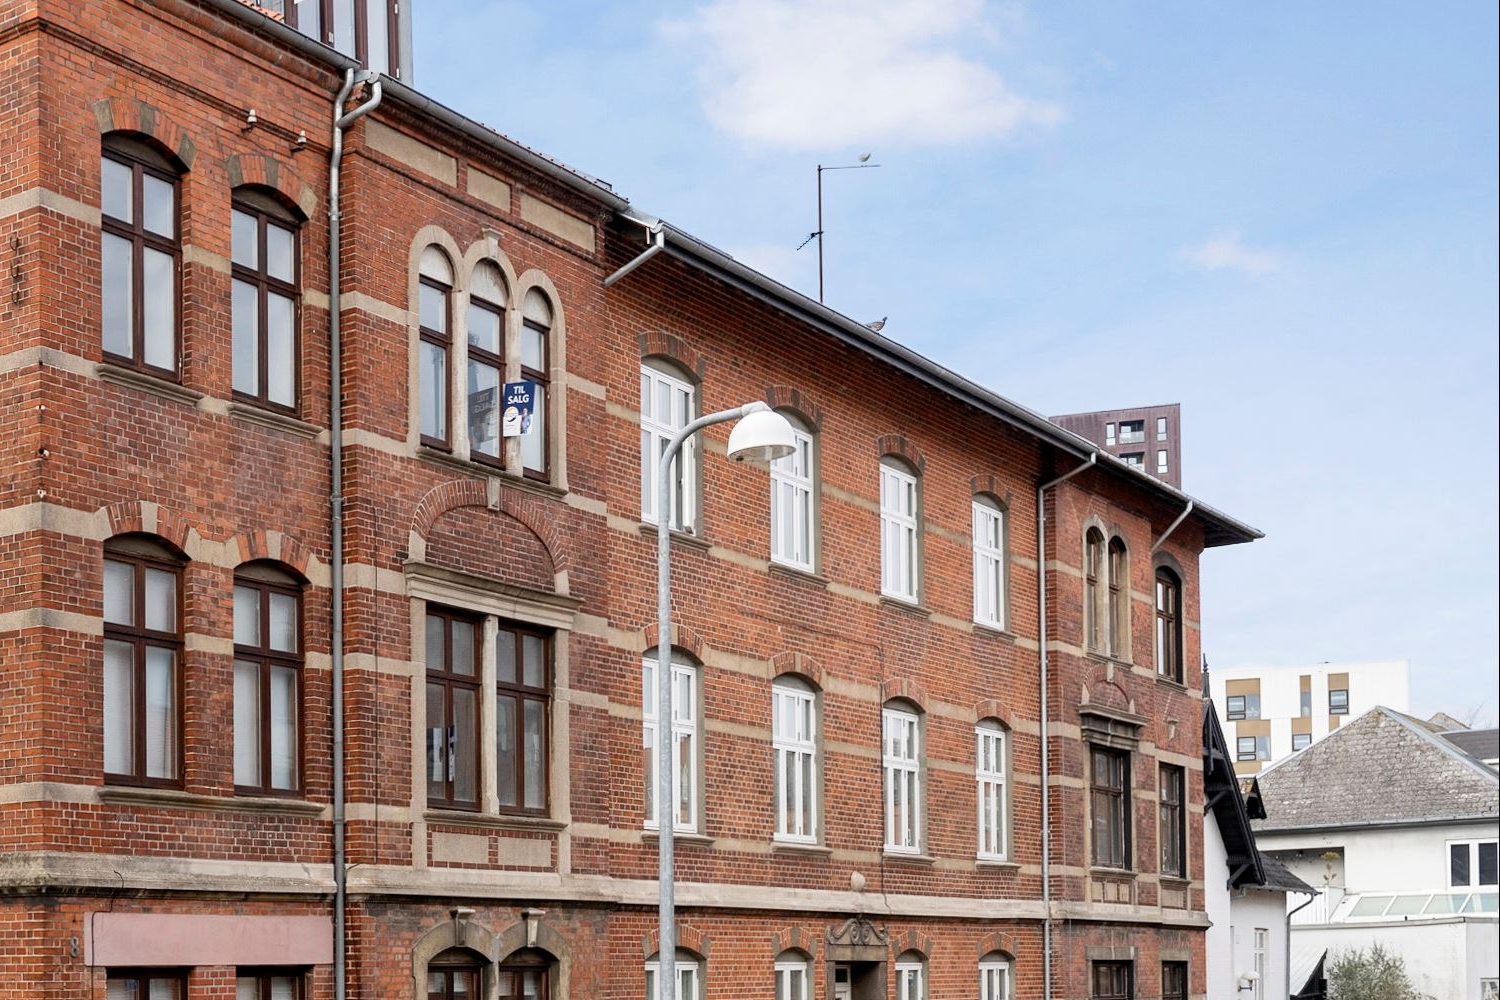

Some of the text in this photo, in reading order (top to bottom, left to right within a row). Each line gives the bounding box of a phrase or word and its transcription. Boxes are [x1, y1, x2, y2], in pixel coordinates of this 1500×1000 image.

[513, 385, 526, 395] TIL
[507, 394, 530, 405] SALG
[71, 936, 79, 957] 8
